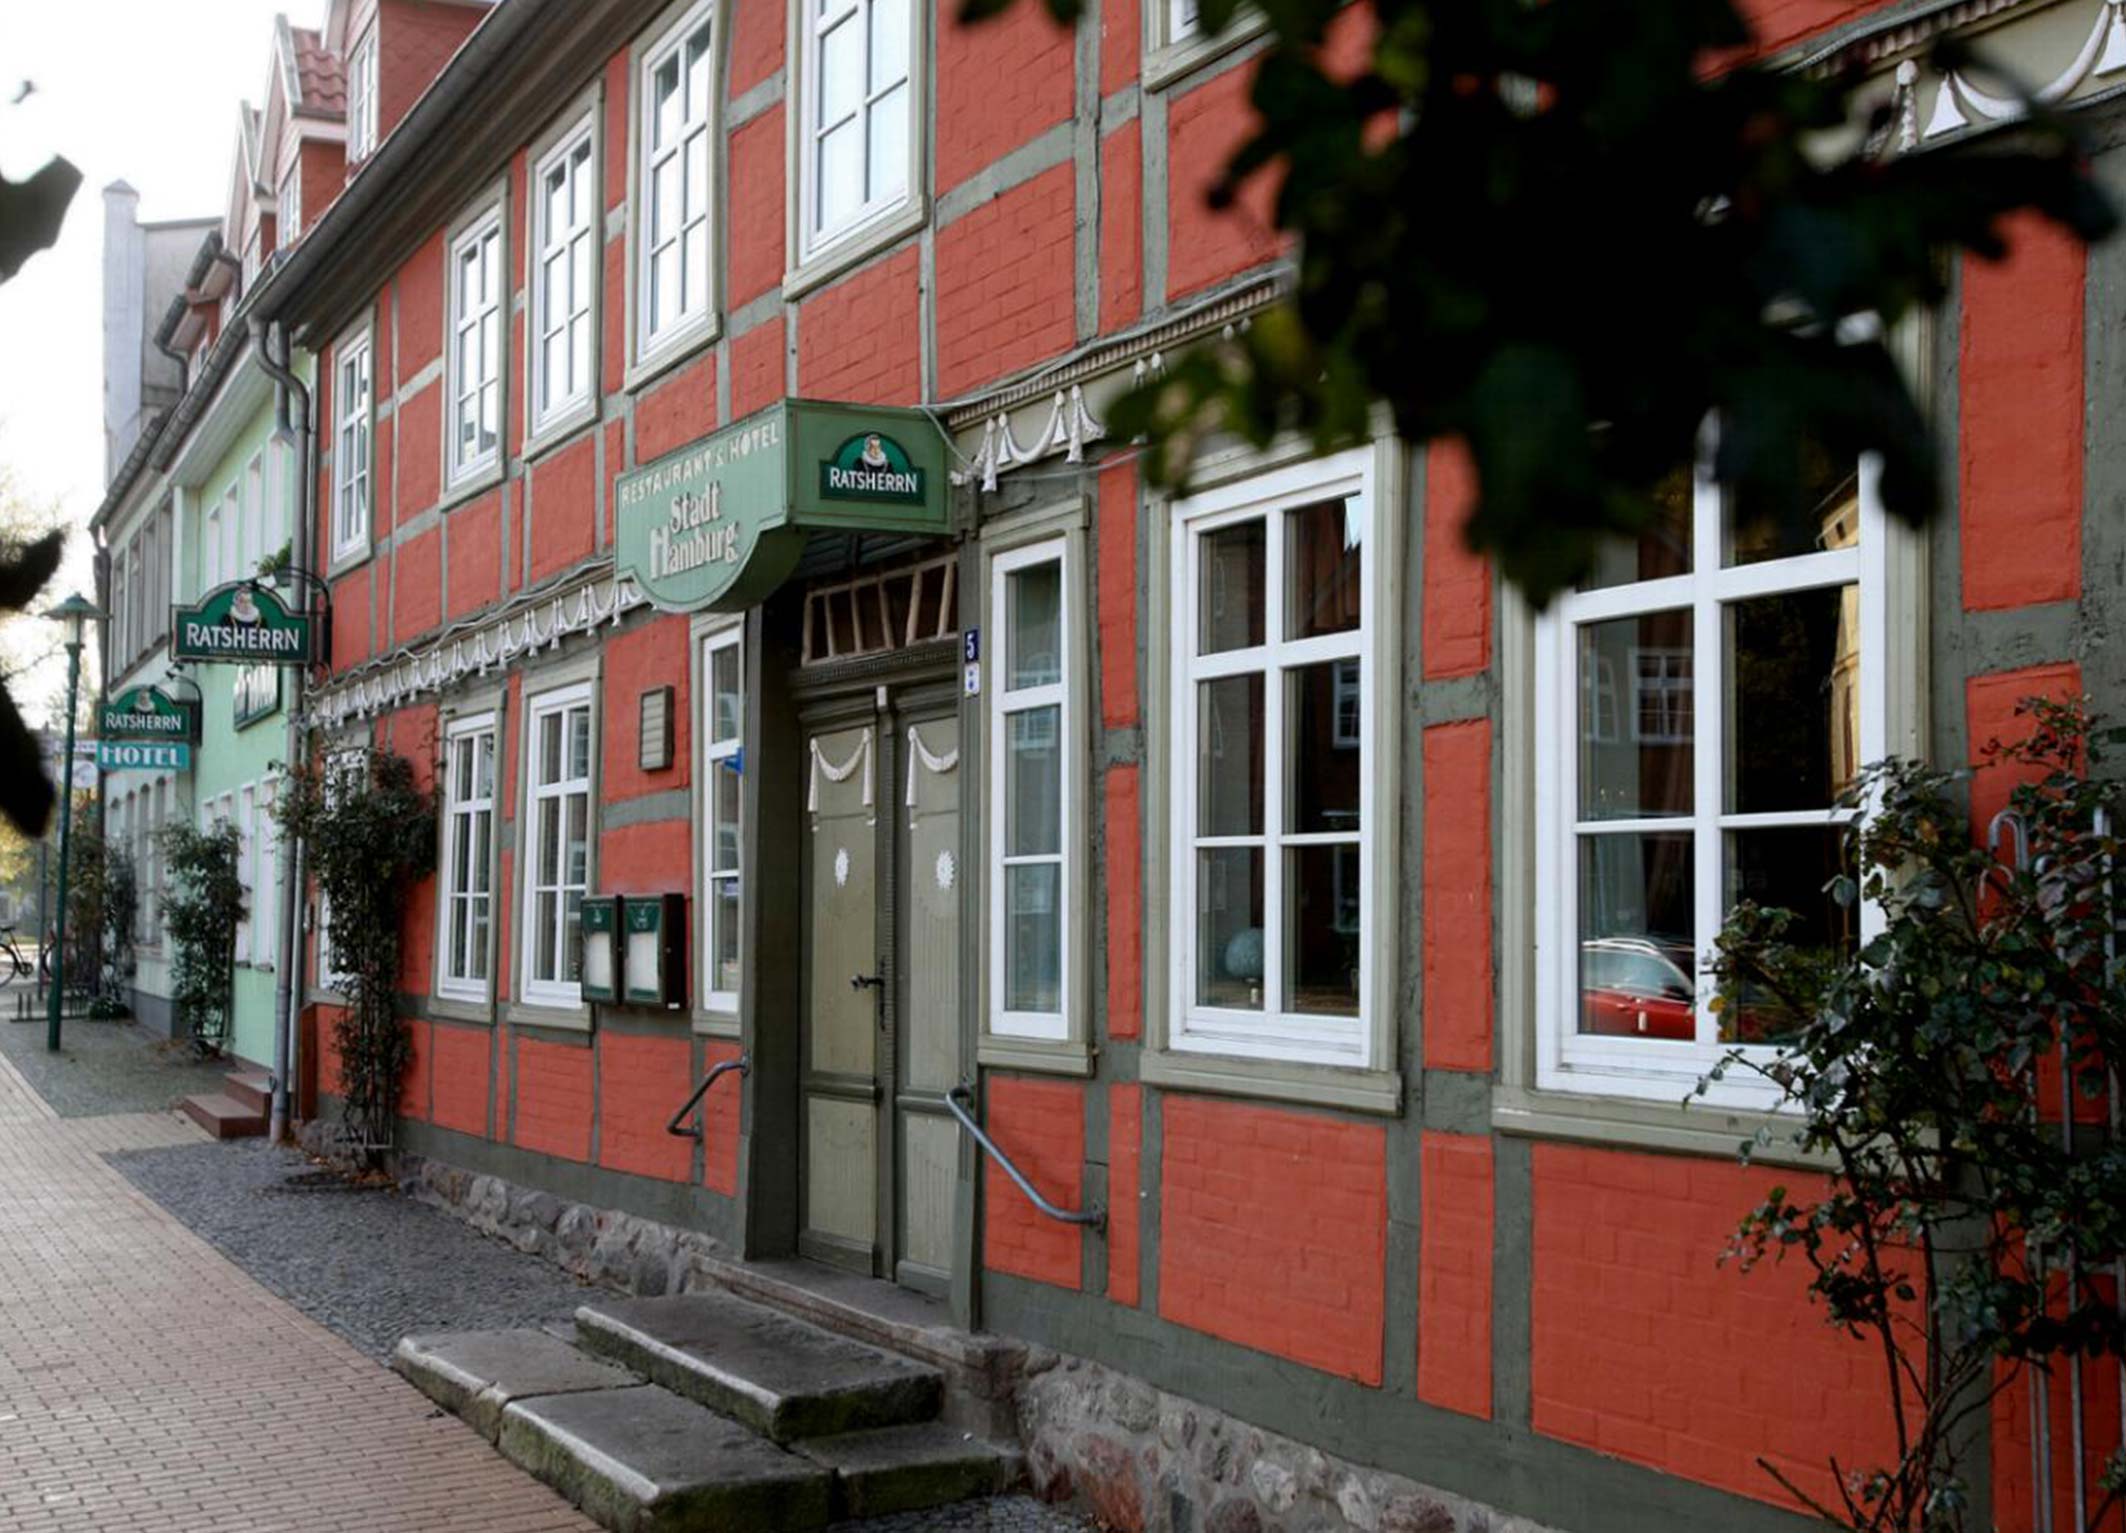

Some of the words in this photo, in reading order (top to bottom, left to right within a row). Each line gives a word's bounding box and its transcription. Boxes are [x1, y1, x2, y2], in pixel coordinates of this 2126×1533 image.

[622, 449, 711, 509] RESTAURANT
[729, 421, 779, 462] HOTEL
[829, 466, 917, 493] RATSHERRN
[671, 481, 721, 534] Stadt
[651, 521, 738, 579] Hamburg
[186, 622, 299, 651] RATSHERRN
[966, 632, 976, 660] 5
[105, 712, 182, 730] RATSHERRN
[101, 743, 180, 766] HOTEL
